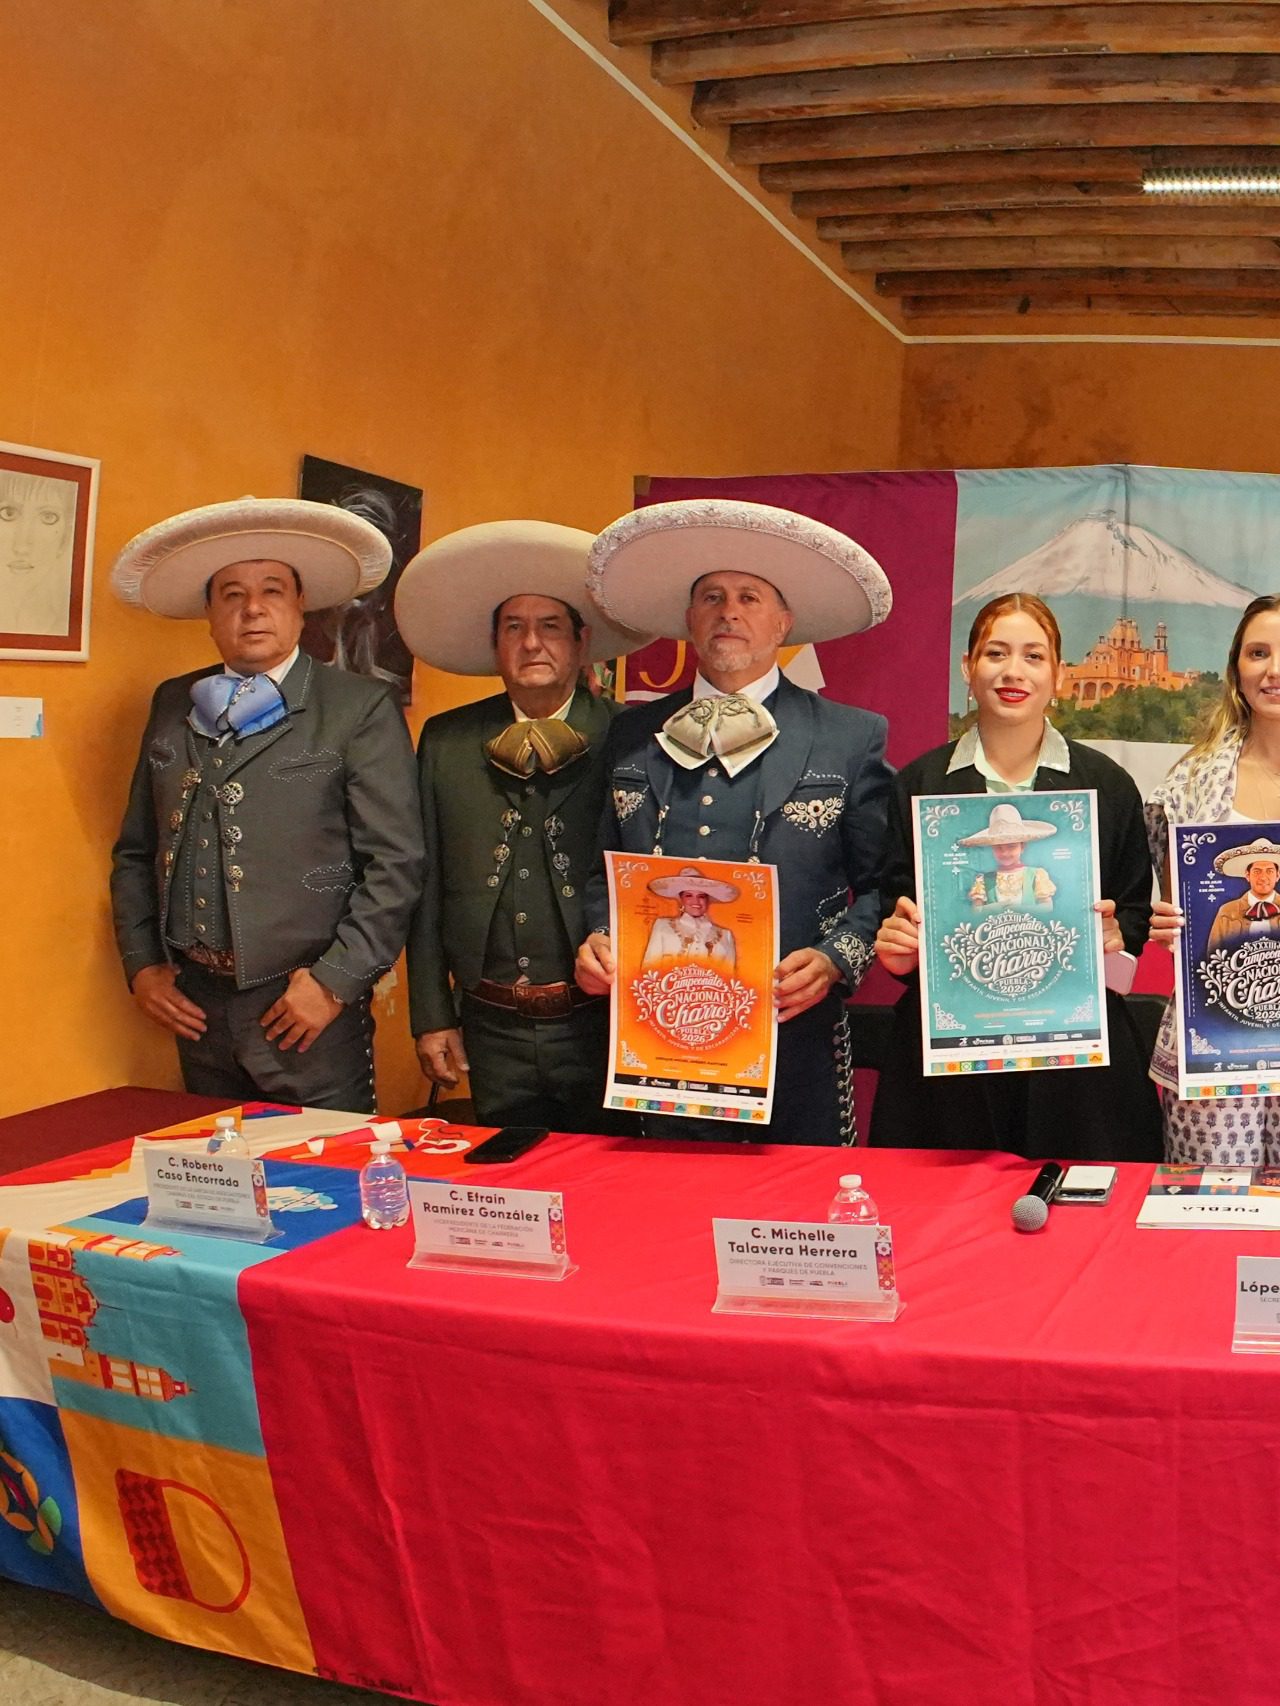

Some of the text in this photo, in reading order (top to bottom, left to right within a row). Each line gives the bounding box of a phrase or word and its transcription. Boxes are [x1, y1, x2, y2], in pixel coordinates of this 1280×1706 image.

[975, 920, 1044, 945] Campeonato
[991, 935, 1048, 957] NACIONAL
[1252, 941, 1277, 951] XXXIII
[970, 949, 1051, 983] Charro
[661, 972, 724, 992] Campeonato
[1001, 985, 1027, 993] 2026
[675, 991, 728, 1005] NACIONAL
[656, 999, 731, 1028] Charro
[681, 1034, 705, 1042] 2026
[168, 1157, 224, 1172] C. Roberto
[157, 1169, 183, 1181] Caso
[449, 1190, 463, 1201] C.
[478, 1206, 540, 1222] González
[751, 1227, 835, 1242] C. Michelle
[728, 1241, 858, 1258] Talavera Herrera
